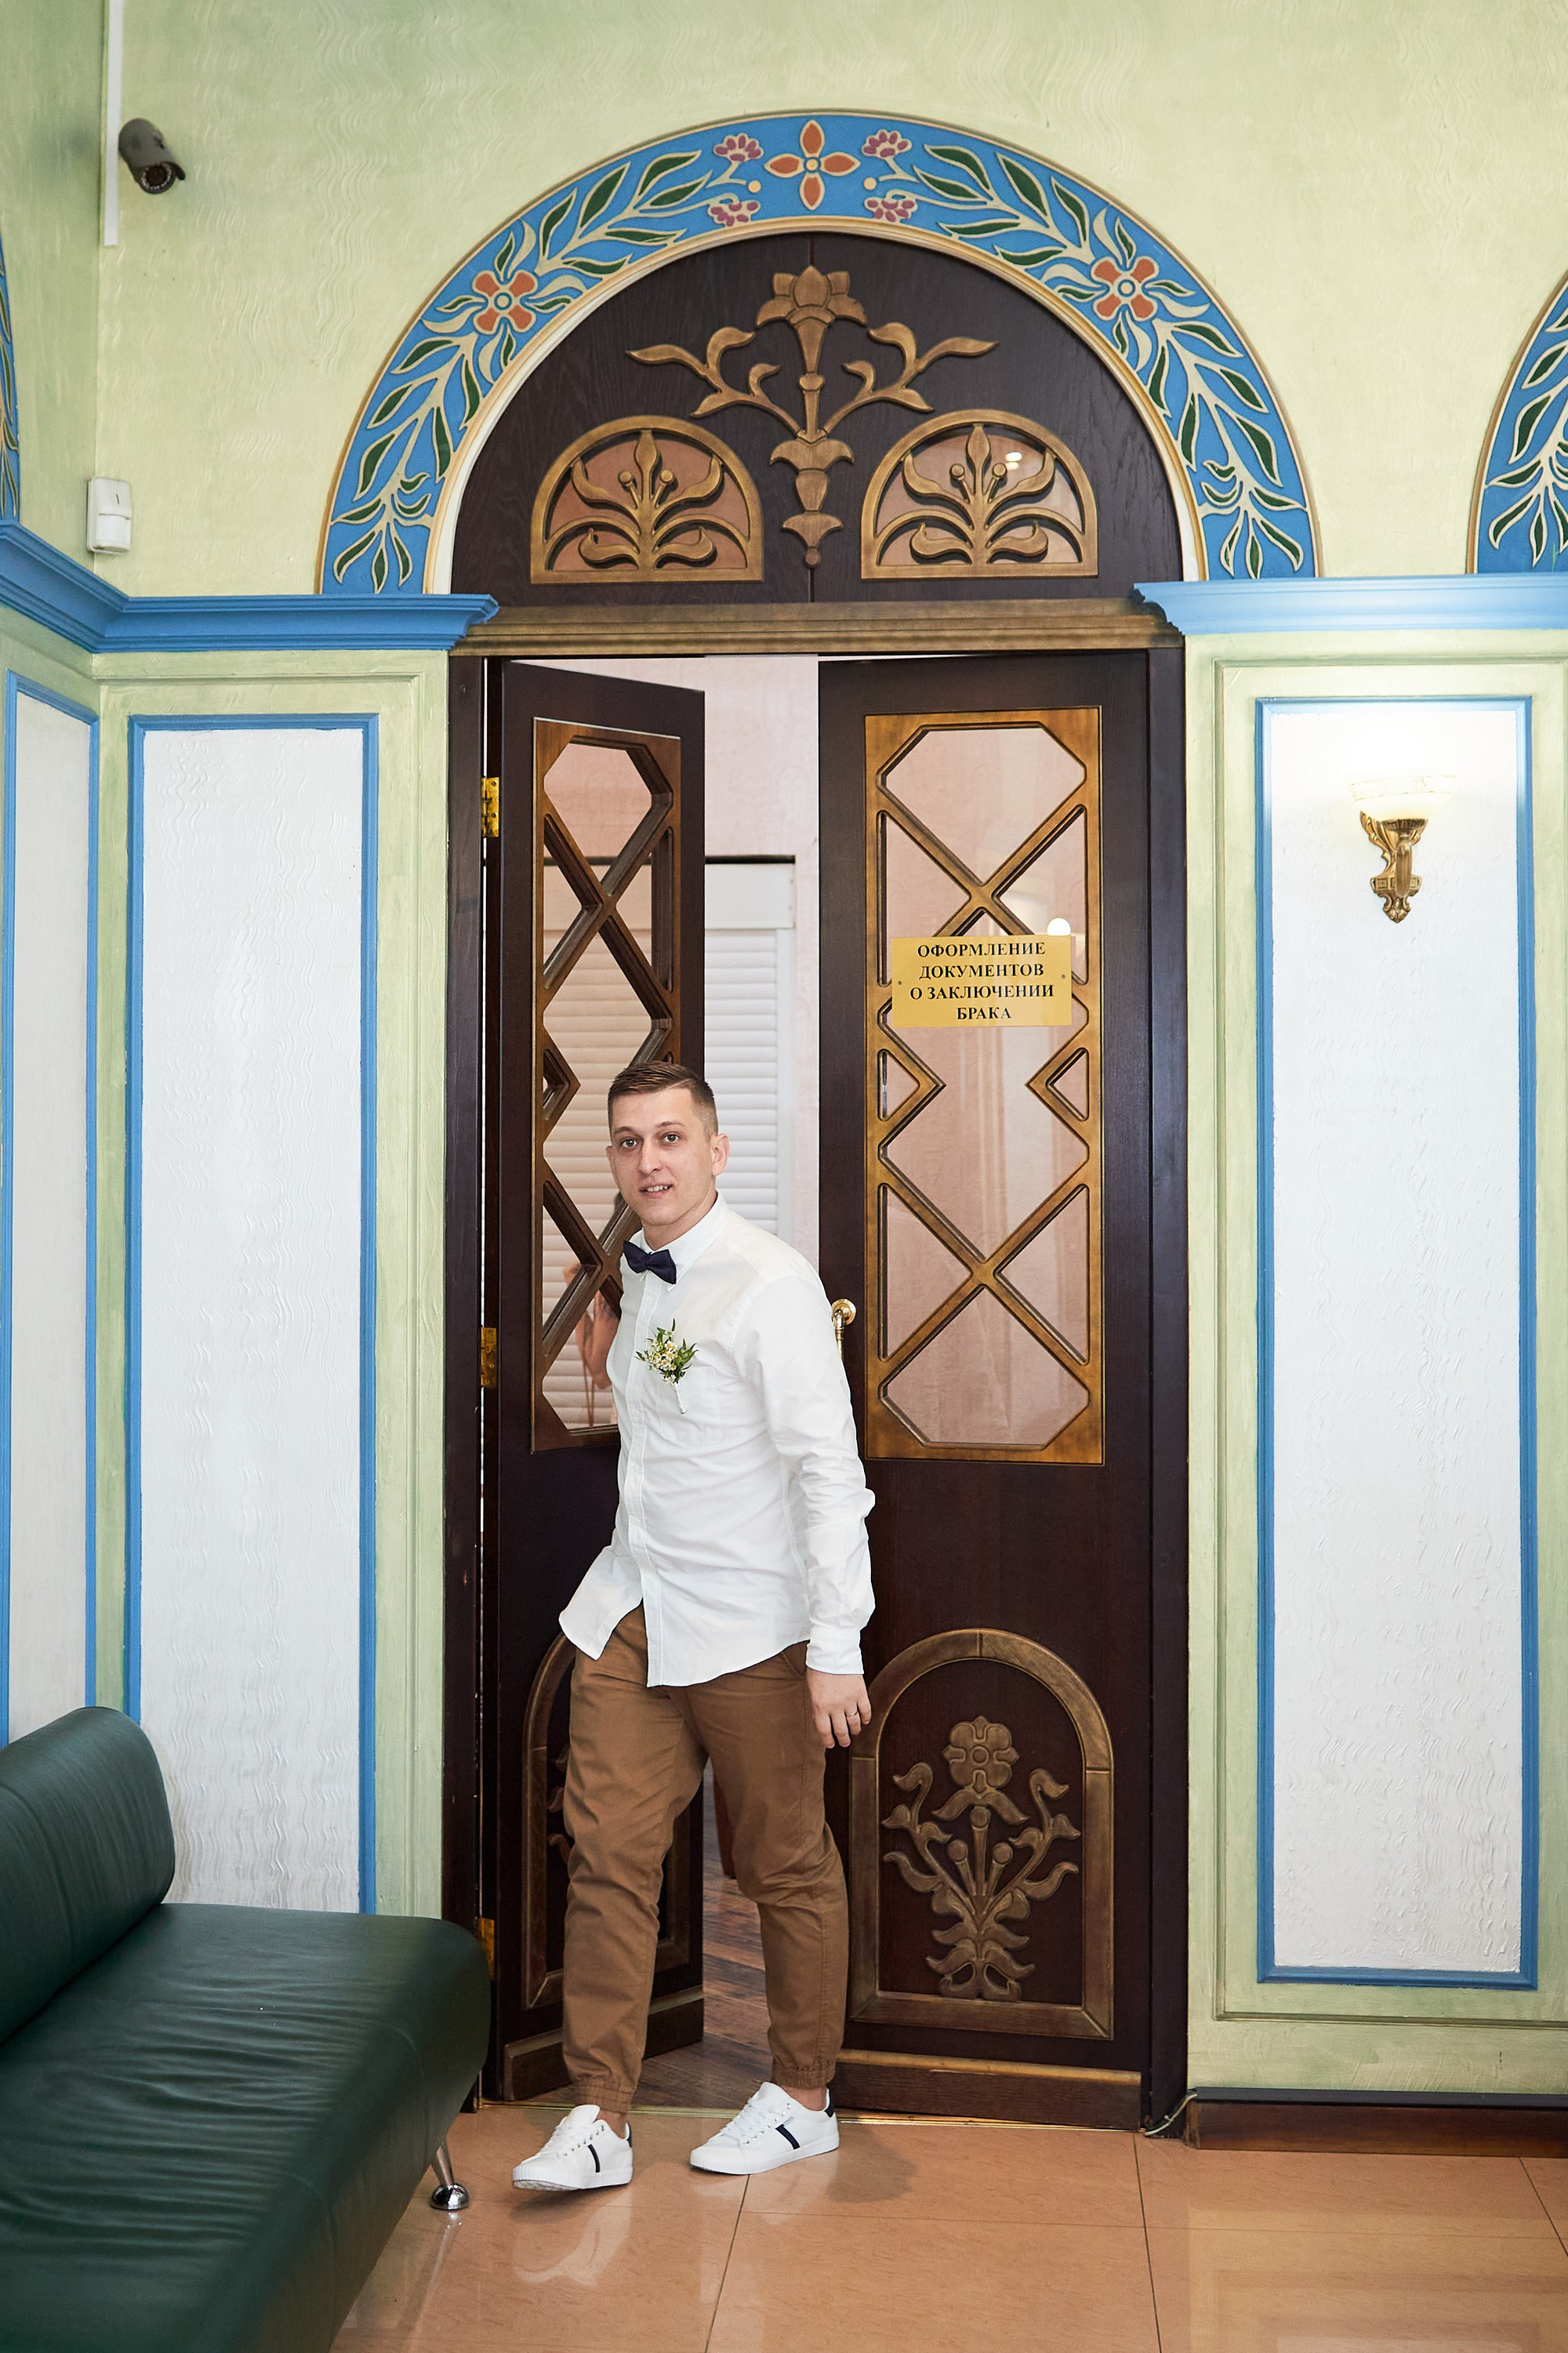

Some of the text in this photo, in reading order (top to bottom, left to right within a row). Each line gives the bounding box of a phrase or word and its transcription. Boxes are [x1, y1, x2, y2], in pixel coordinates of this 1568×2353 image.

[917, 942, 1046, 957] ОФОРМЛЕНИЕ
[919, 963, 1044, 980] ДОКУМЕНТОВ
[909, 985, 1054, 1000] О ЗАКЛЮЧЕНИИ
[956, 1007, 1011, 1020] БРАКА
